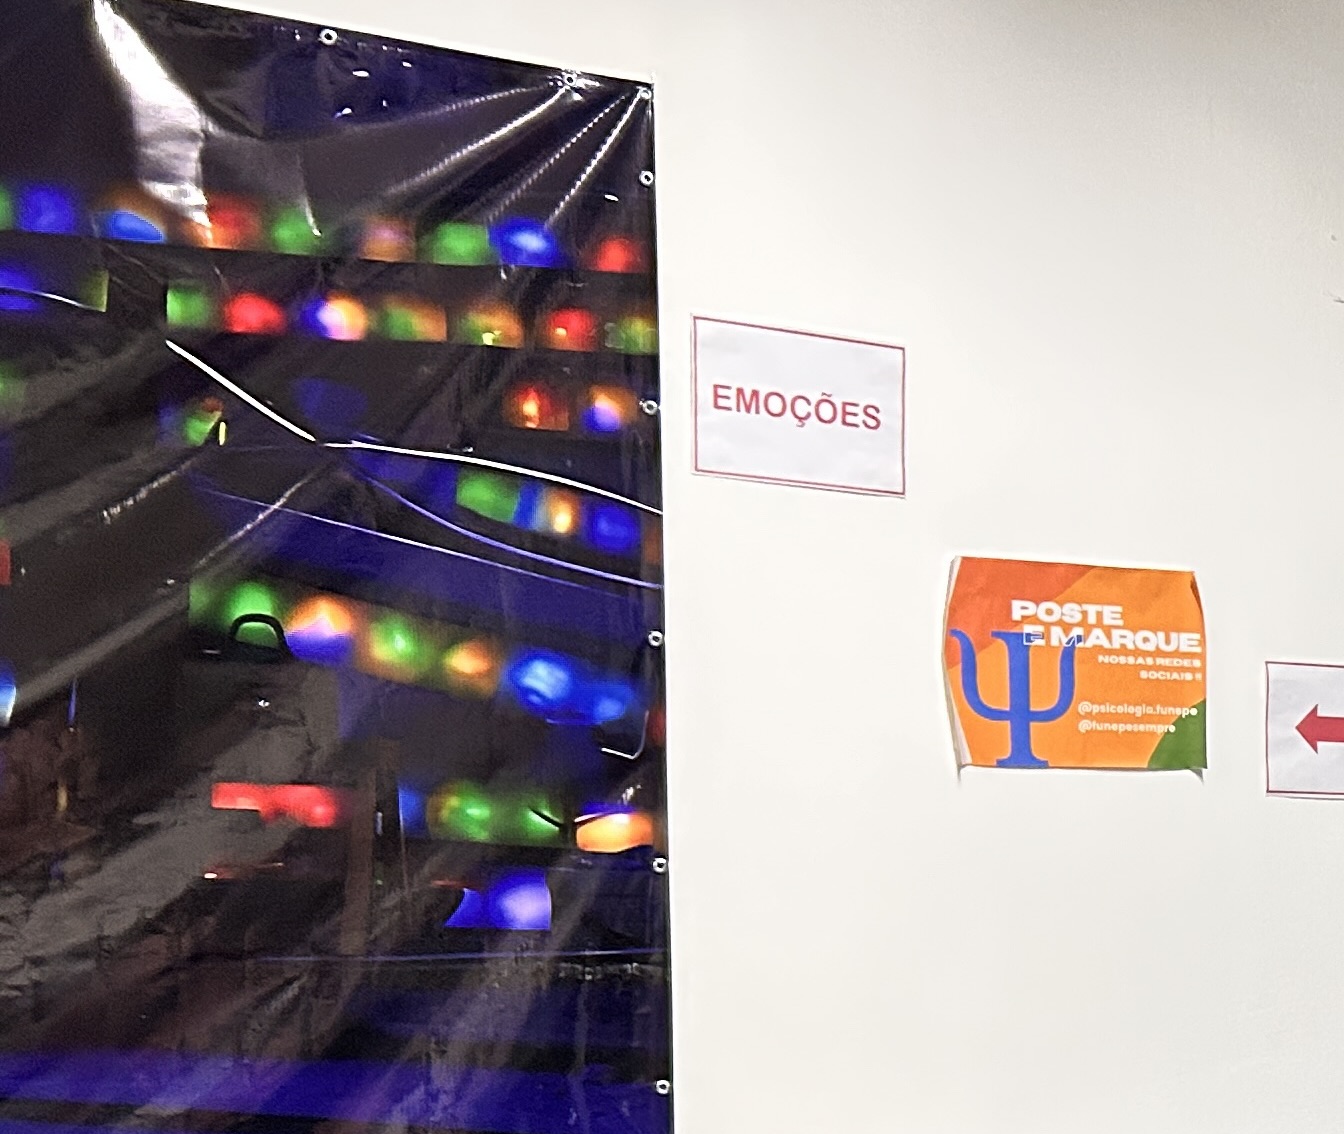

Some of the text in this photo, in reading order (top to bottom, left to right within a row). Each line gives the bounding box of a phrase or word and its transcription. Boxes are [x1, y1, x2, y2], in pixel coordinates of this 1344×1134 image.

[712, 383, 882, 431] EMOÇÕES
[1010, 599, 1125, 627] POSTE
[1023, 624, 1202, 654] E MARQUE
[1097, 654, 1202, 668] NOSSAS REDES
[1139, 669, 1193, 681] SOCIAIS
